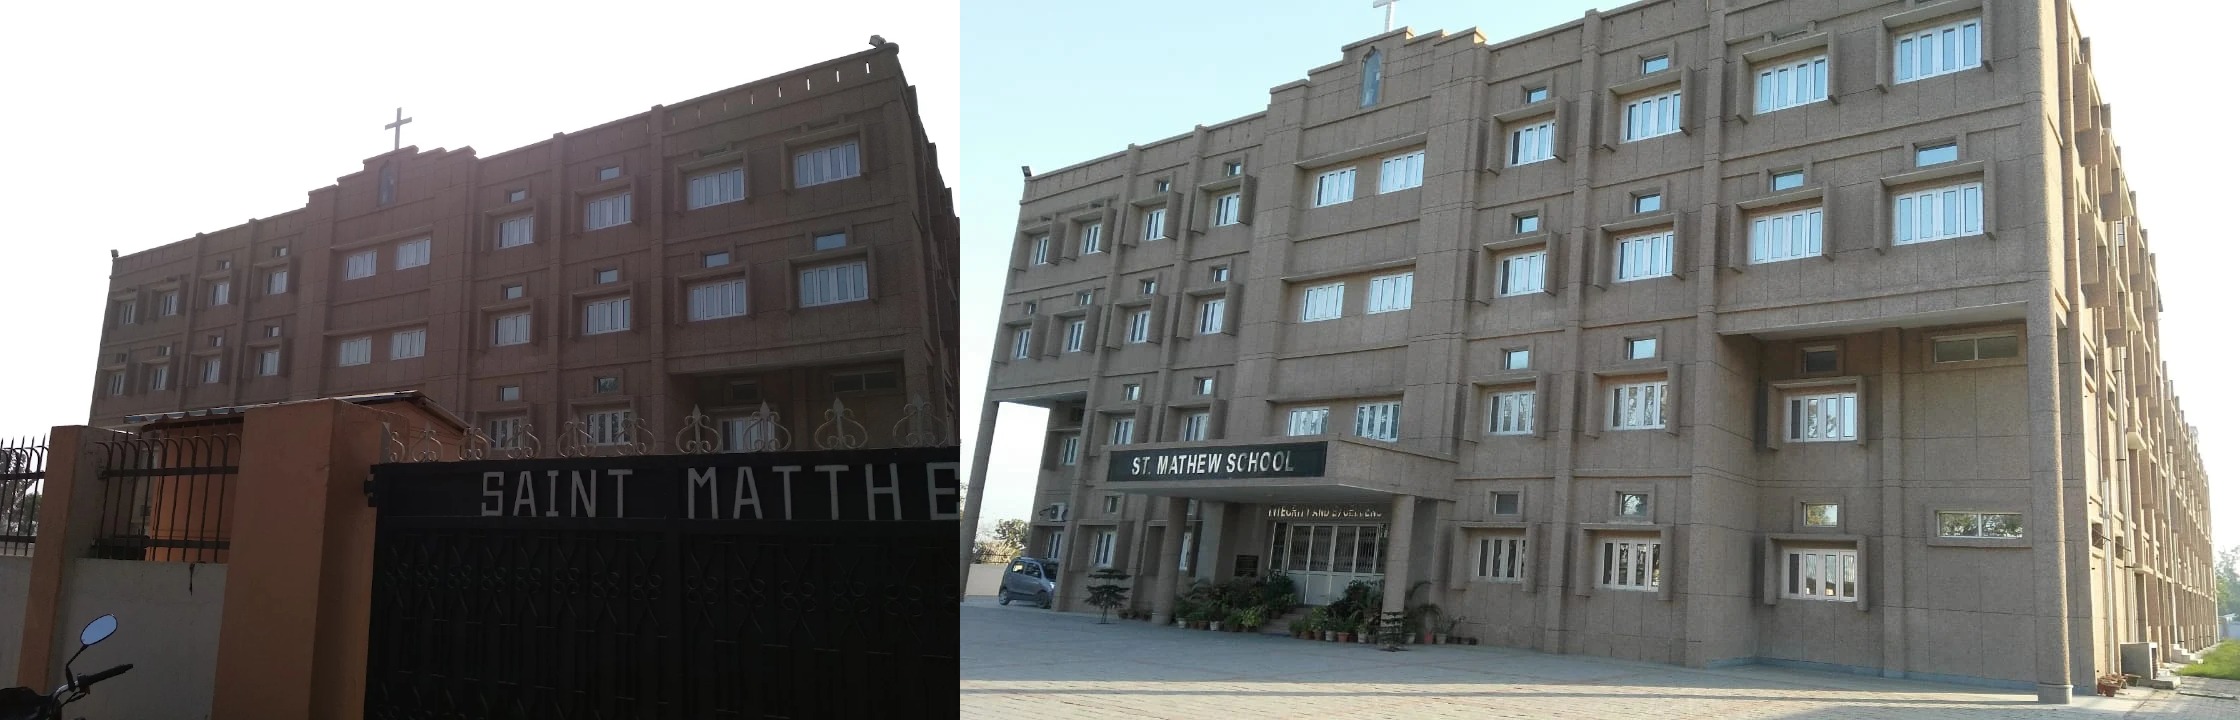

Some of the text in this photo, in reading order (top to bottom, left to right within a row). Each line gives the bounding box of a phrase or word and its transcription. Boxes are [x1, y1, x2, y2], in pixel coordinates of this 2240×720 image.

[1131, 451, 1294, 475] ST. MATHEW SCHOOL
[481, 461, 960, 520] SAINT MATTHE
